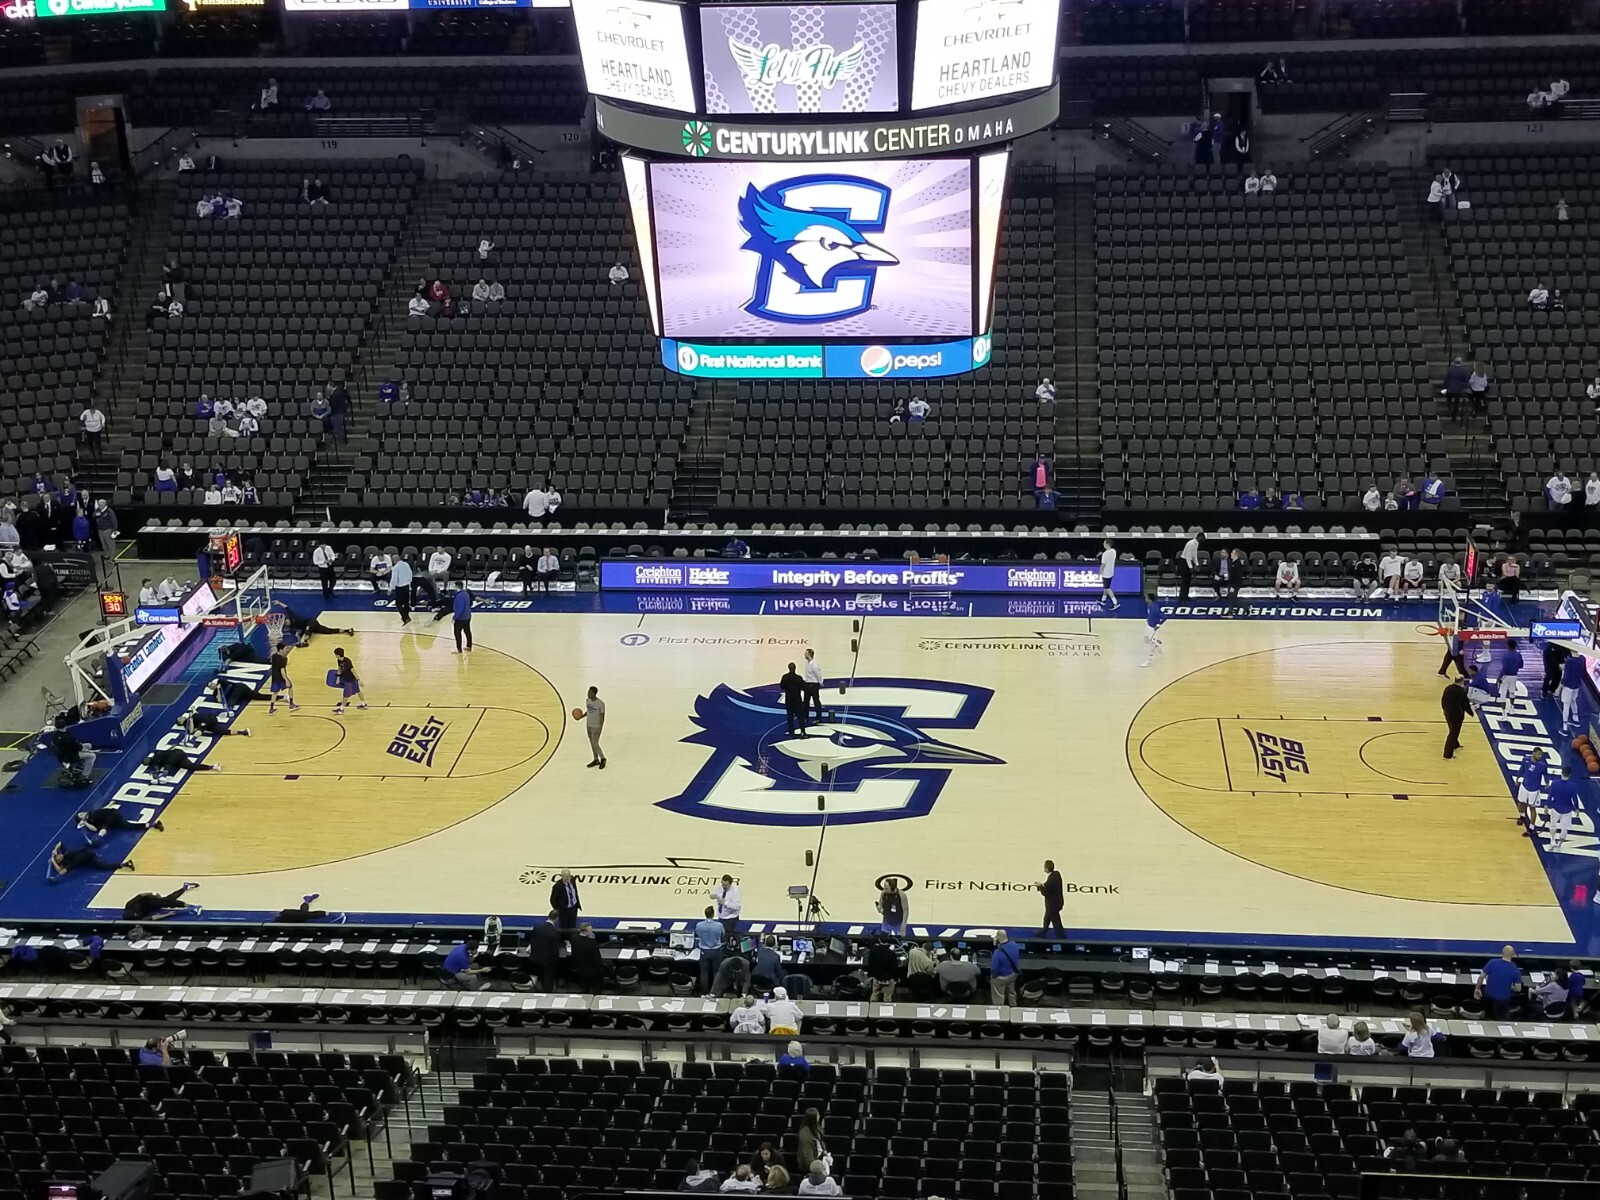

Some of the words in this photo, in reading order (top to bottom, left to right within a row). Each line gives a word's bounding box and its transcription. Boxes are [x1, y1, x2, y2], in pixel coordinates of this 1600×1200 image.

[596, 31, 665, 51] CHEVROLET
[944, 22, 1032, 47] CHEVROLET
[600, 59, 673, 86] HEARTLAND
[940, 51, 1032, 82] HEARTLAND
[634, 83, 676, 102] DEALERS
[938, 81, 977, 99] CHEVY
[979, 71, 1030, 91] DEALERS
[321, 140, 338, 149] 119
[562, 132, 580, 142] 120
[716, 128, 869, 155] CENTURYLINK
[873, 123, 950, 152] CENTER
[954, 117, 1014, 144] OMAHA
[699, 353, 725, 368] First
[726, 353, 785, 369] National
[786, 352, 823, 369] Bank
[893, 351, 942, 370] pepsi
[635, 565, 682, 578] Creighton
[688, 567, 730, 580] Heider
[772, 569, 841, 586] Integrity
[844, 570, 899, 585] Before
[1007, 568, 1057, 581] Creighton
[108, 603, 121, 612] 30
[658, 635, 689, 645] First
[692, 636, 764, 645] National
[767, 636, 810, 645] Bank
[944, 642, 1044, 650] CENTURYLINK
[1047, 643, 1101, 651] CENTER
[386, 723, 420, 758] BIG
[405, 715, 445, 764] EAST
[1256, 731, 1287, 783] EAST
[1279, 737, 1309, 774] BIG
[550, 873, 671, 885] CNTURYLINK
[676, 875, 741, 887] CENTR
[924, 879, 963, 891] First
[969, 880, 1040, 892] Nation
[1066, 883, 1121, 895] Bank
